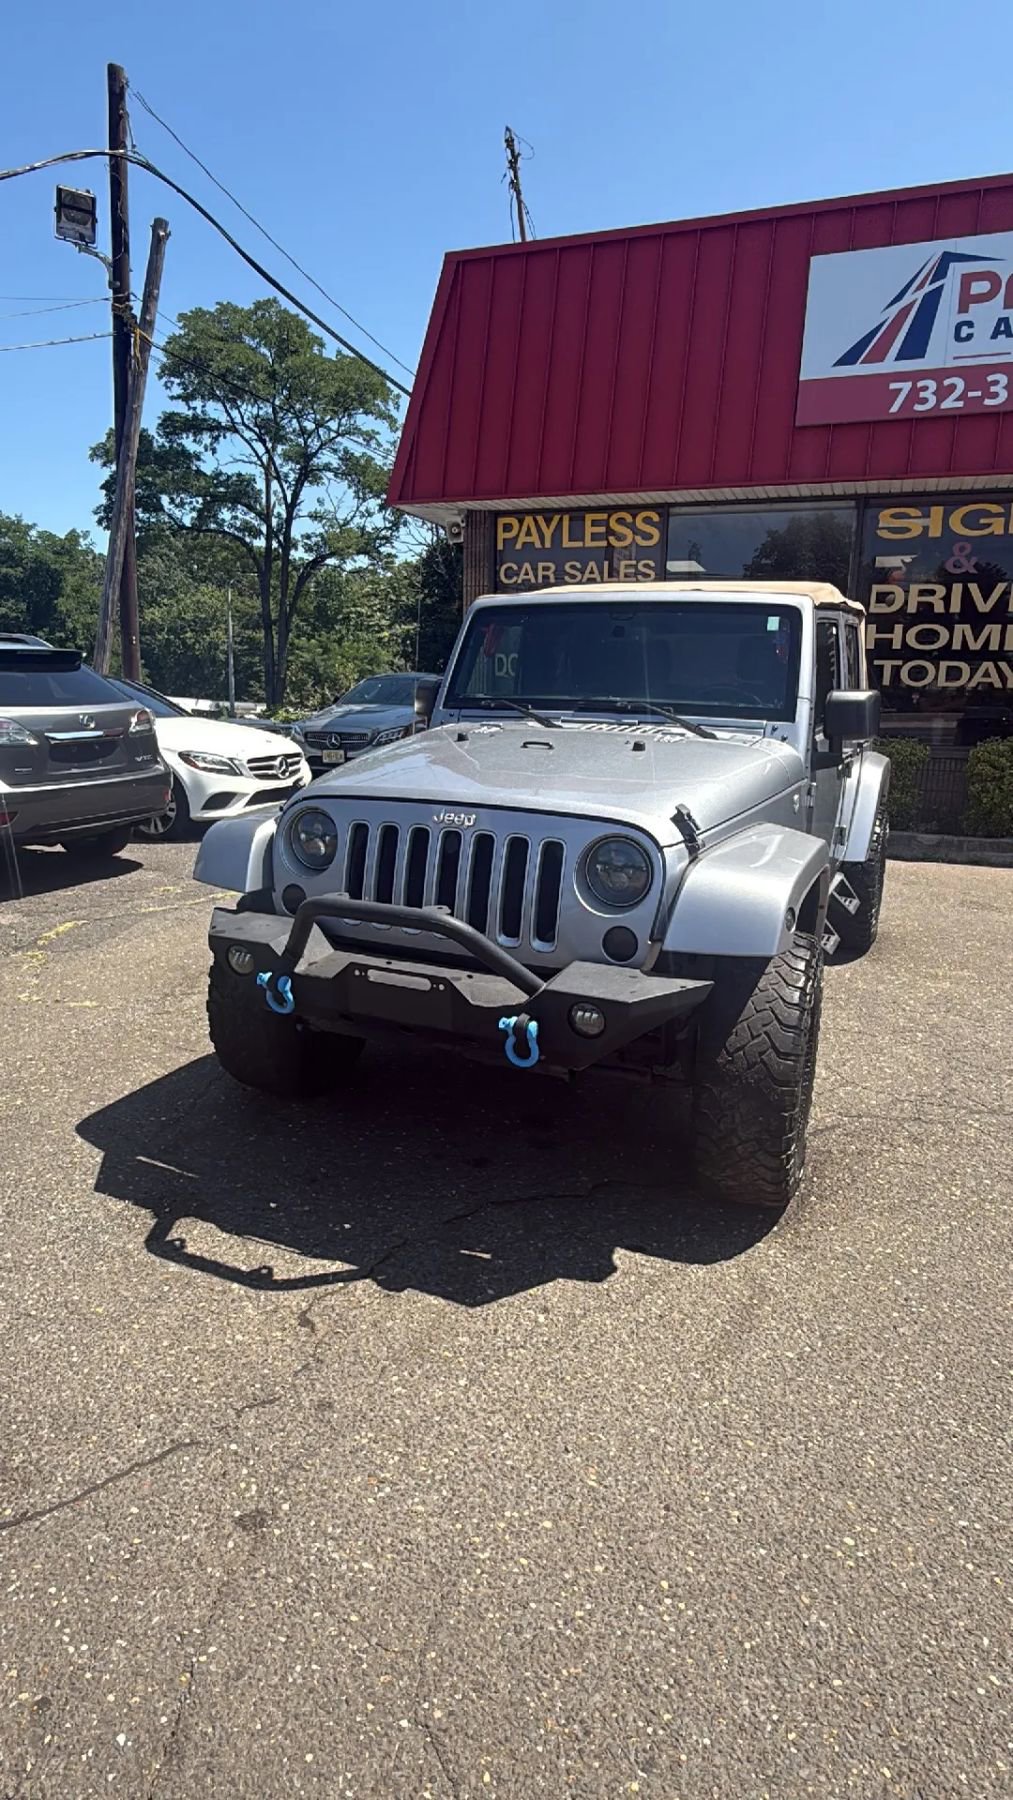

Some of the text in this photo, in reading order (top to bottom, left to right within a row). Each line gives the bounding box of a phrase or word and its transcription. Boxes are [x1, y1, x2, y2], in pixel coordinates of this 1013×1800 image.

[957, 270, 1013, 315] P
[888, 373, 1009, 414] 732-3
[497, 511, 660, 550] PAYLESS
[876, 502, 1013, 540] SIG
[500, 560, 656, 584] CAR SALES
[944, 541, 978, 575] &
[868, 582, 1013, 614] DRIV
[433, 808, 477, 829] Jeep
